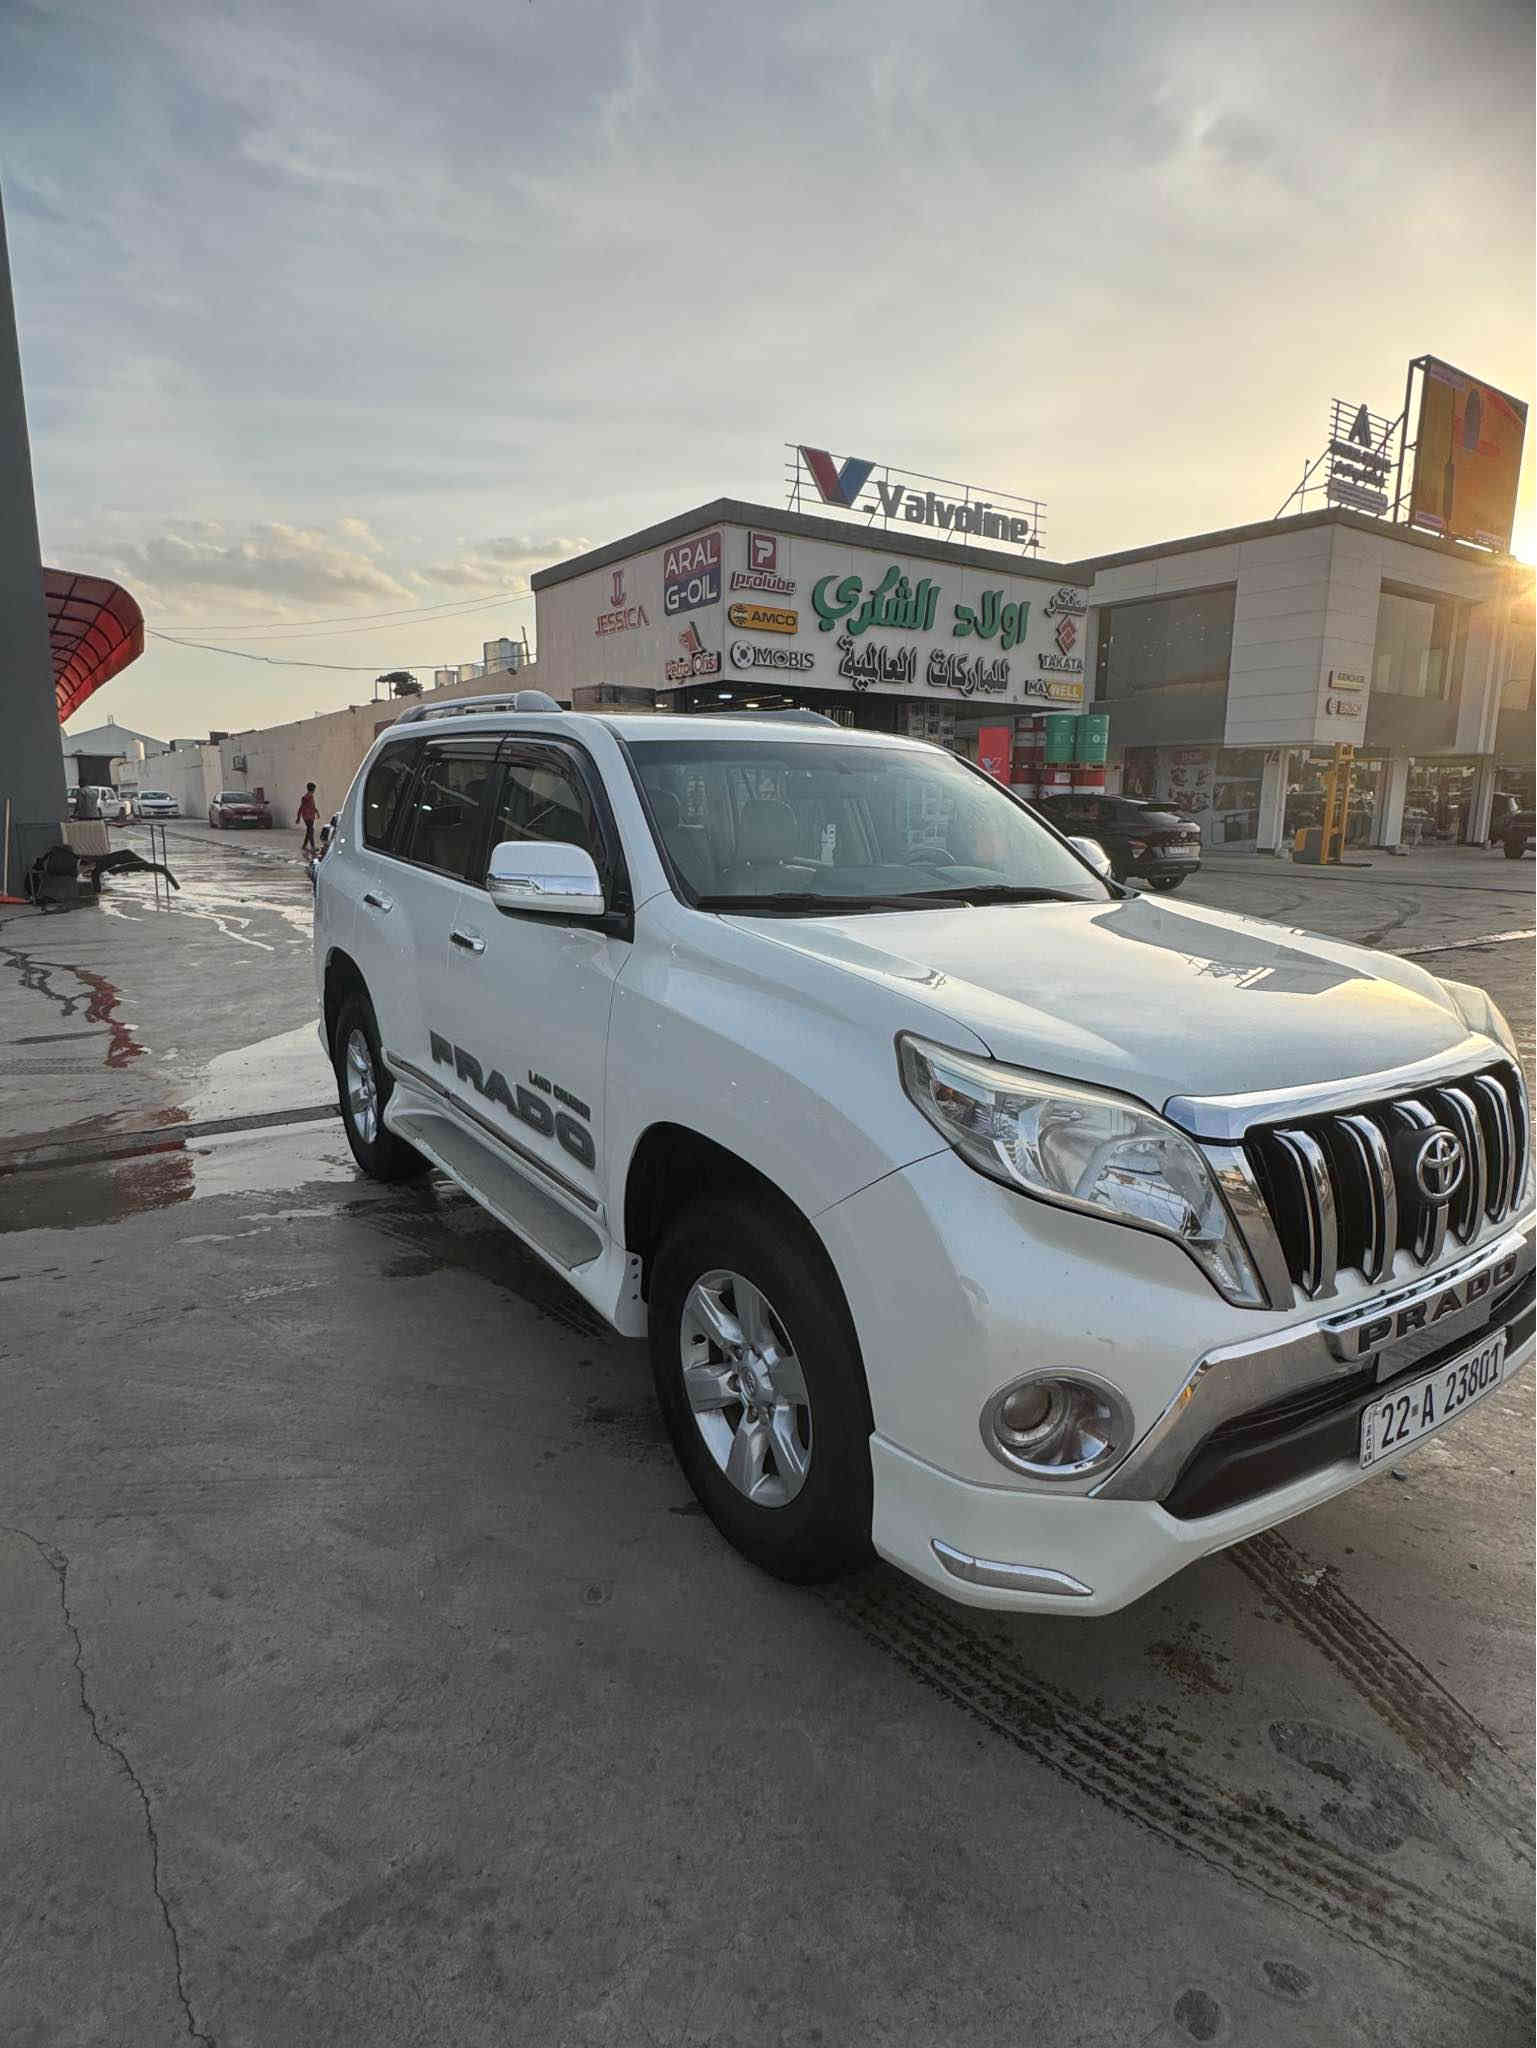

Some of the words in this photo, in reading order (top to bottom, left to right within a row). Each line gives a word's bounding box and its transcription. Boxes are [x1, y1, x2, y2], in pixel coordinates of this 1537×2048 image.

[876, 481, 1029, 543] Valvoline
[665, 540, 718, 578] ARAL
[666, 574, 718, 610] G-OIL
[733, 573, 796, 592] prolube
[595, 606, 649, 638] JESSICA
[751, 611, 796, 626] AMCO
[755, 648, 815, 669] MOBIS
[430, 1030, 596, 1170] PRADO
[1358, 1252, 1517, 1355] PRADO
[1443, 1342, 1500, 1414] 23801
